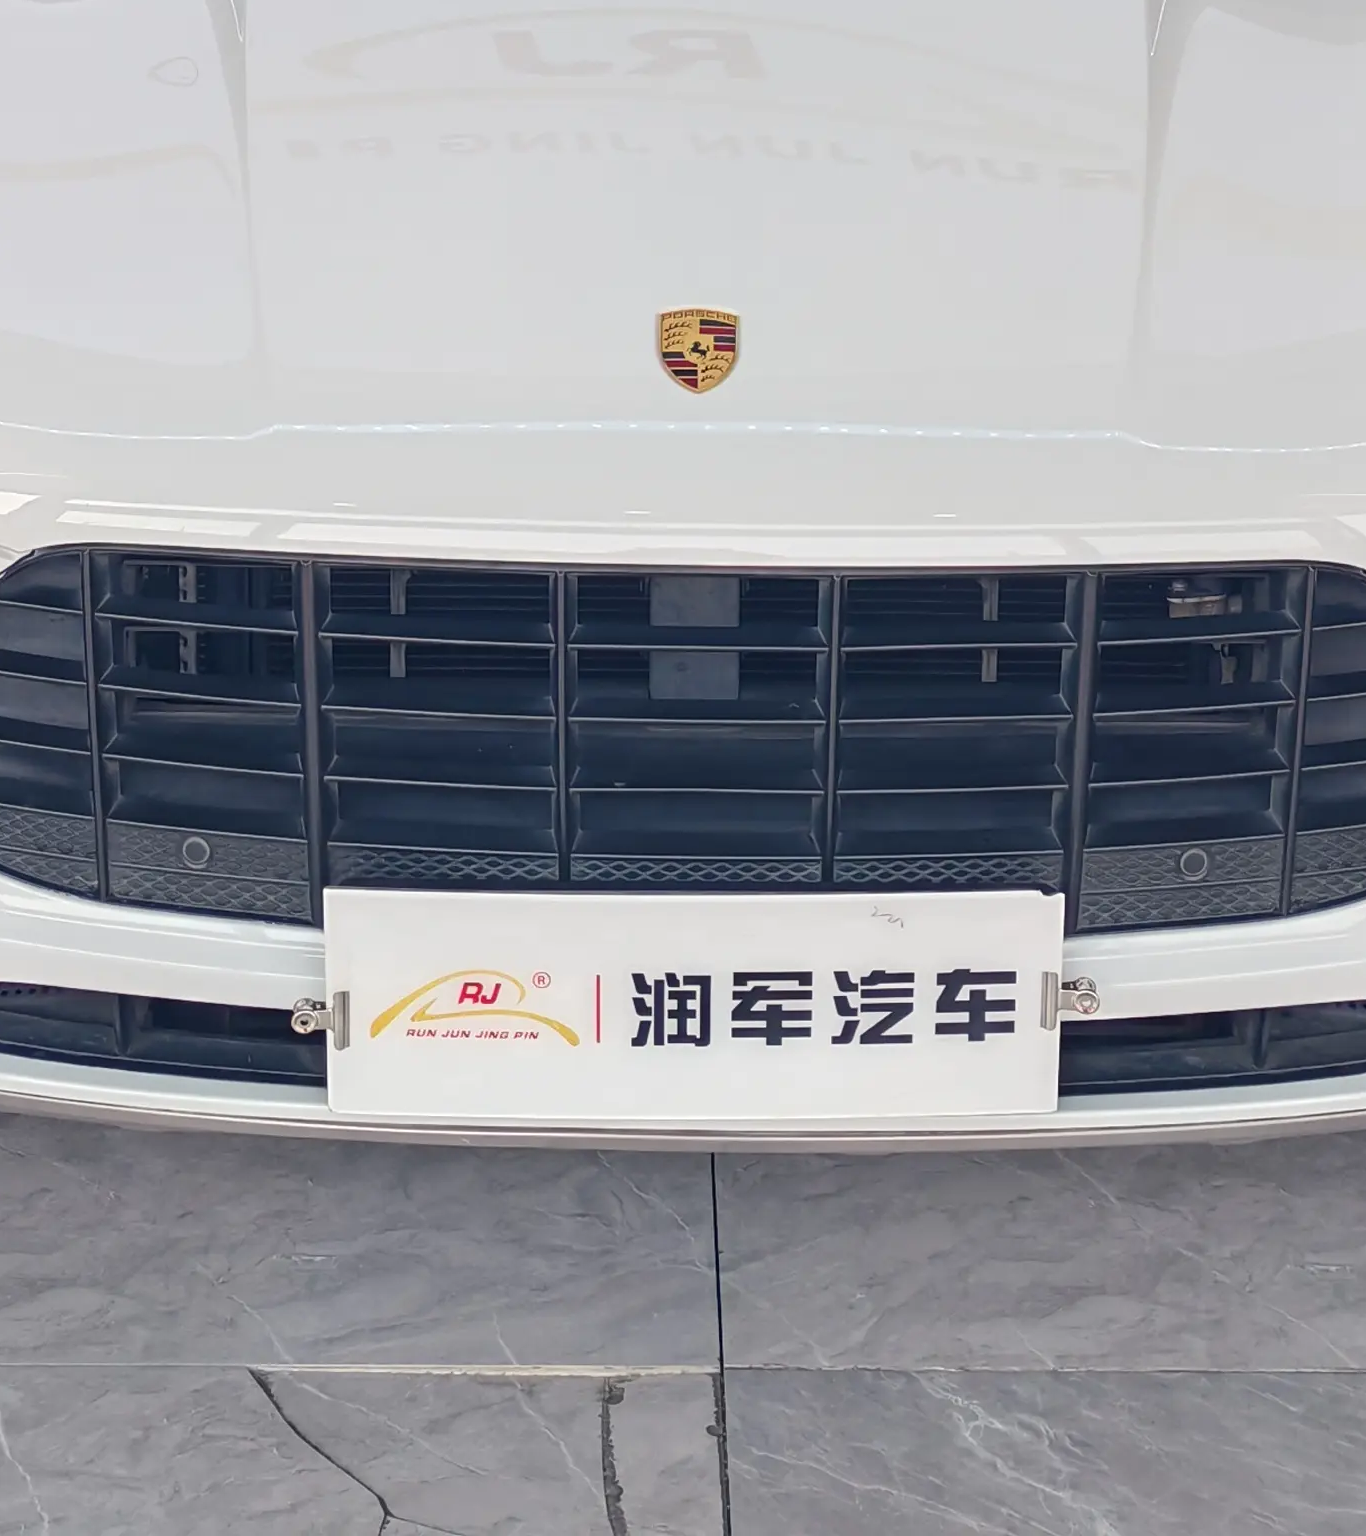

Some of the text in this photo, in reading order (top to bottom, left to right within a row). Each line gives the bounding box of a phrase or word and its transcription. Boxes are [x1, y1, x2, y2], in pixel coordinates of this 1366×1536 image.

[661, 309, 737, 322] PORSCHE
[458, 982, 502, 1004] RJ
[631, 969, 1017, 1046] 润军汽车
[406, 1029, 540, 1040] RUN JUN JING PIN
